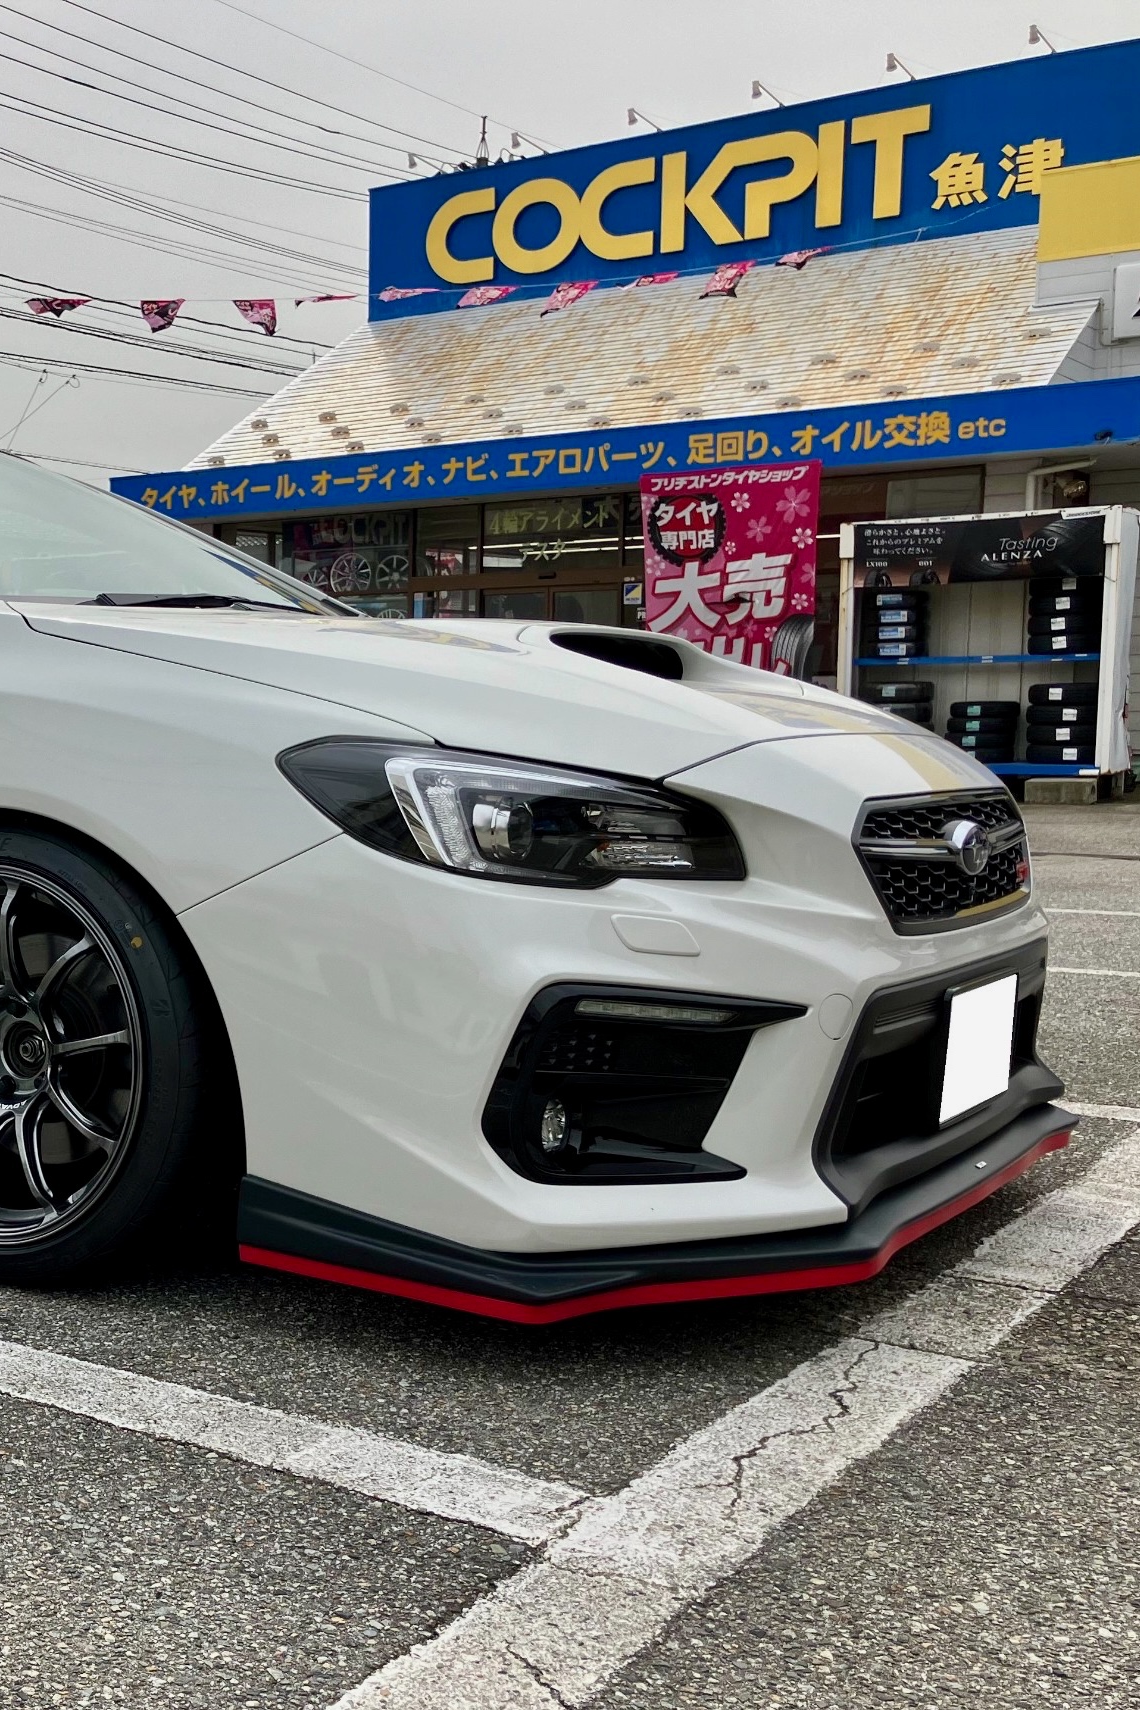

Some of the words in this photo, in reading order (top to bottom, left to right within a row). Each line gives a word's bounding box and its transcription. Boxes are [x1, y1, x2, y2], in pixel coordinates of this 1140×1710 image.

[425, 104, 932, 284] COCKPIT
[932, 138, 1066, 210] 魚津
[958, 417, 1007, 440] etc
[654, 501, 719, 527] タイヤ
[659, 529, 716, 550] 専門店
[999, 536, 1059, 552] Tasting
[980, 549, 1043, 562] ALENZA
[648, 552, 793, 632] 大売
